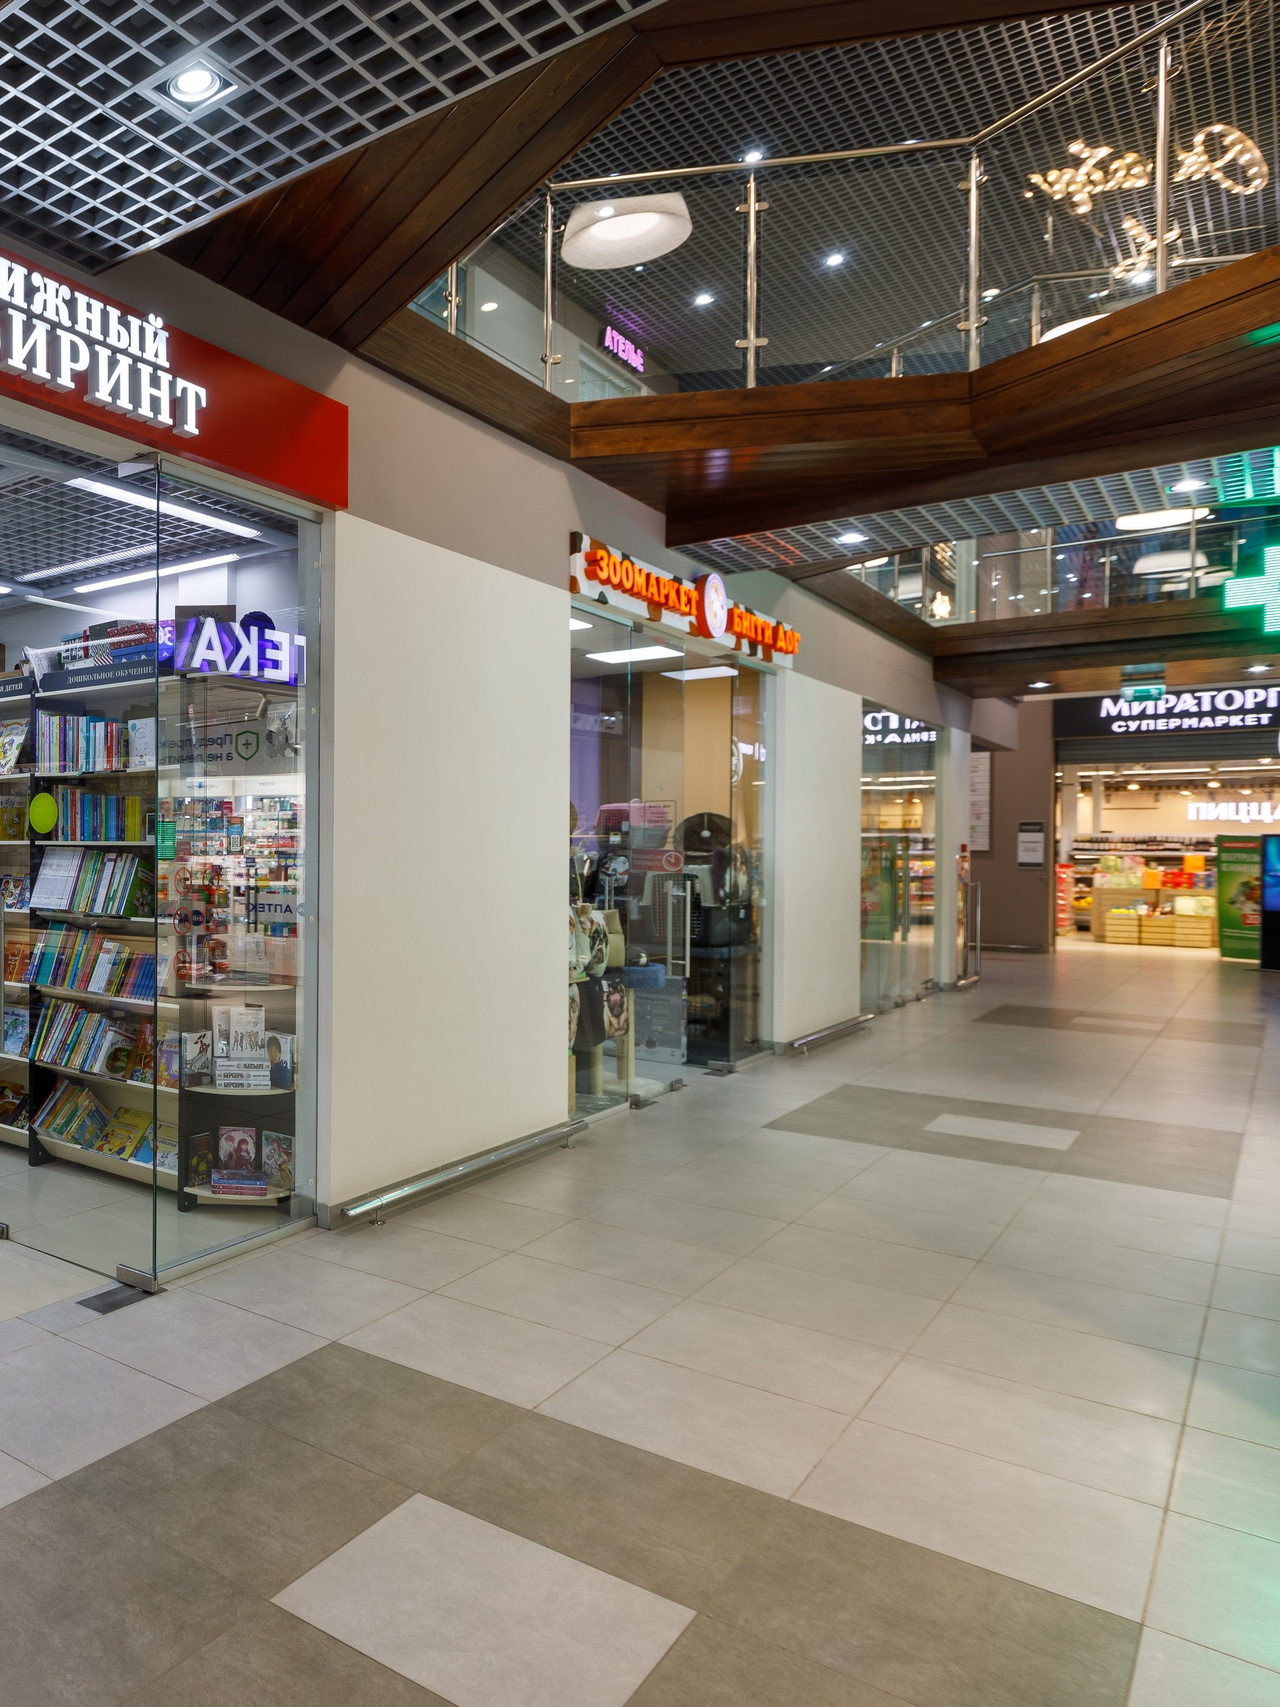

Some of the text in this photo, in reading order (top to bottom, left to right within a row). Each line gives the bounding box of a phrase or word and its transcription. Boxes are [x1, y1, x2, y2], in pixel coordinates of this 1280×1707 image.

[604, 325, 645, 373] АТЕЛЬЕ
[595, 549, 700, 616] ЗООМАРКЕТ
[4, 682, 23, 693] ДЕТЕЙ
[66, 666, 154, 685] ДОШКОЛЬНОЕ ОБУЧЕНИЕ
[1099, 687, 1280, 718] МИРАТОРГ
[1110, 714, 1273, 733] СУПЕРМАРКЕТ
